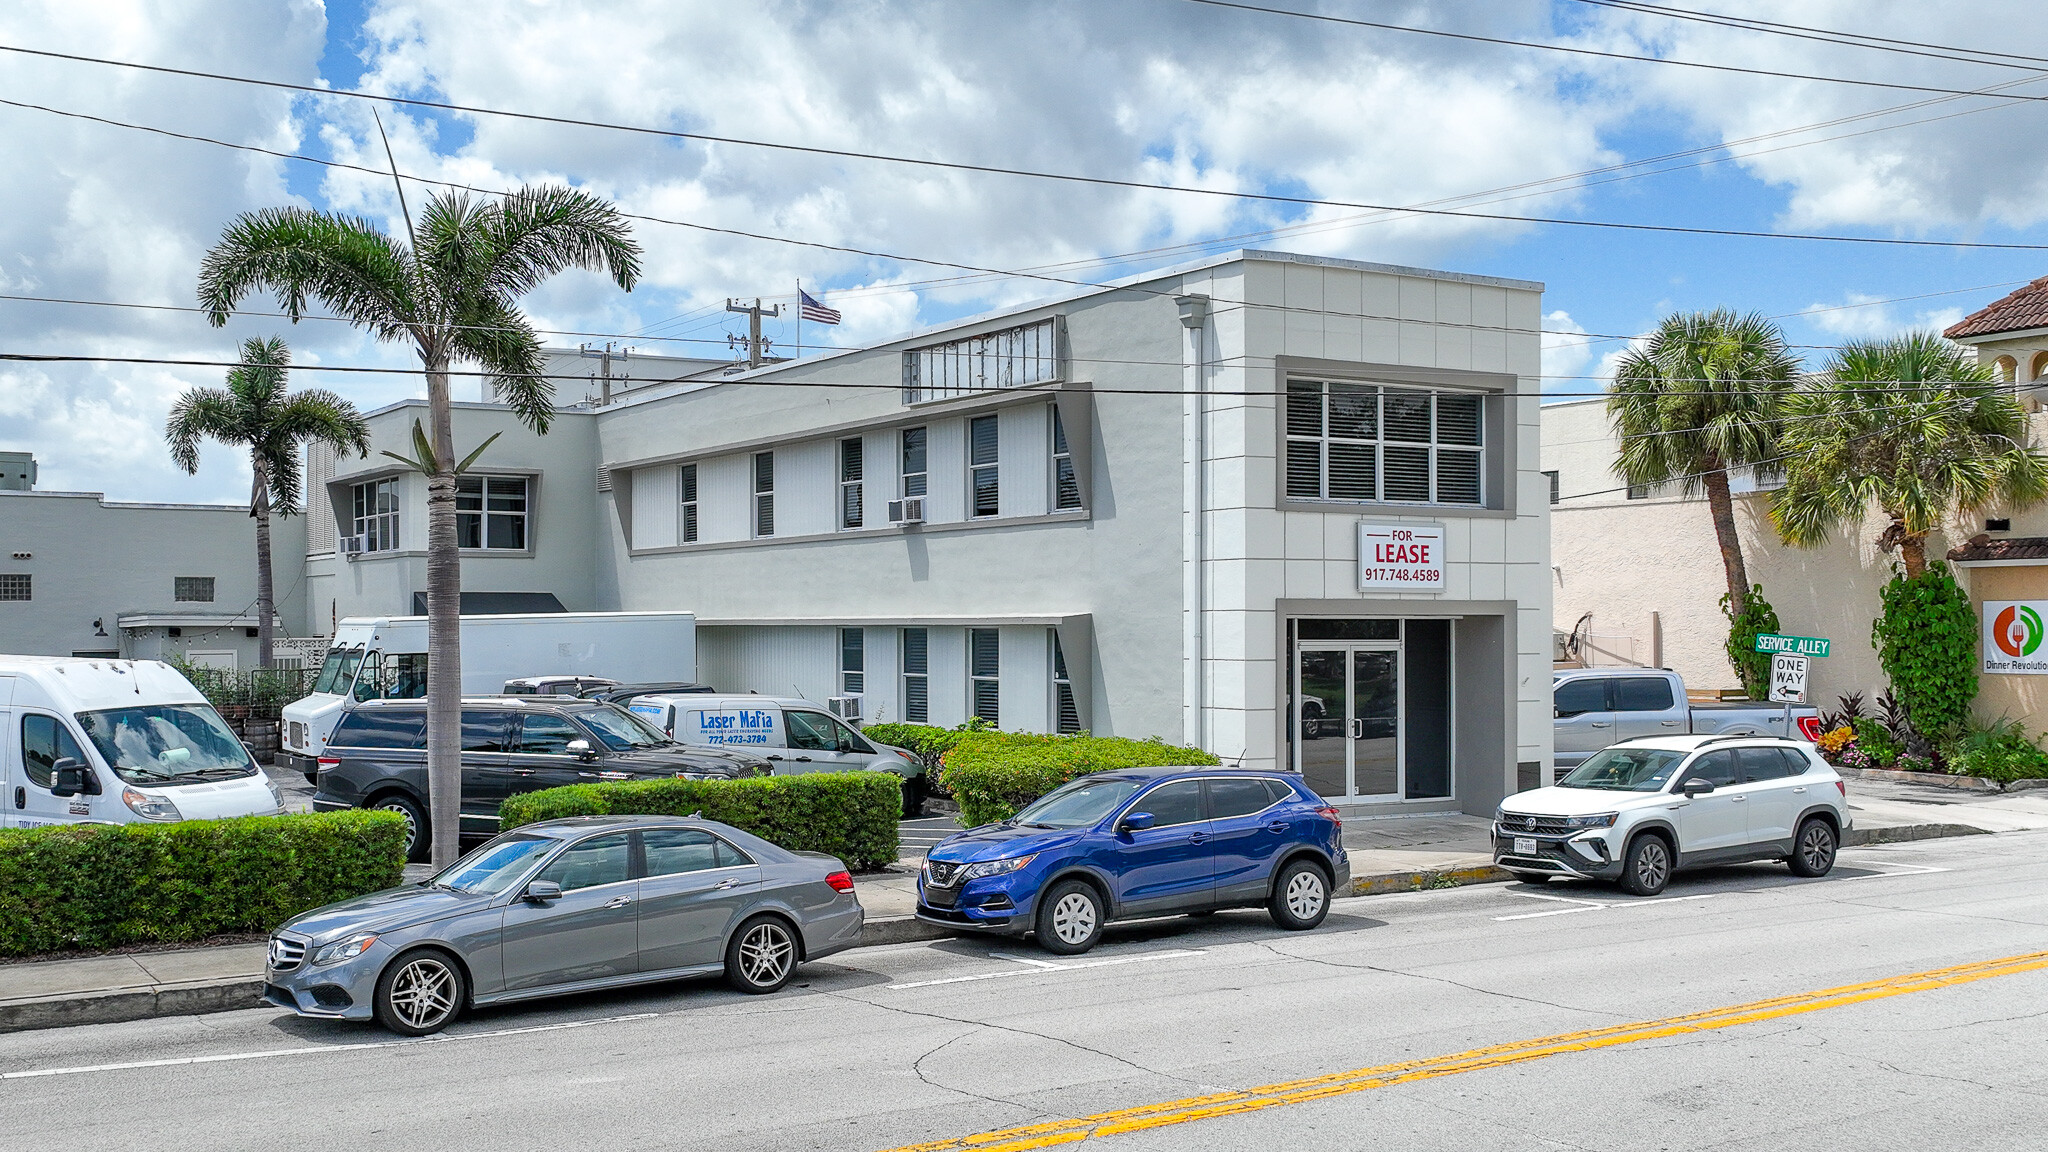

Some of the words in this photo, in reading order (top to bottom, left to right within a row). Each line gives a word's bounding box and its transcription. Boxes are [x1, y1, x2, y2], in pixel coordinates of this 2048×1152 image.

[1392, 530, 1413, 541] FOR
[1376, 543, 1430, 564] LEASE
[1365, 568, 1440, 582] 917.748.4589
[1757, 636, 1794, 652] SERVICE
[1797, 639, 1829, 654] ALLEY
[1777, 659, 1804, 671] ONE
[1986, 660, 2010, 670] Dinner
[2011, 660, 2048, 670] Revolutio
[1776, 672, 1804, 684] WAY
[700, 710, 736, 729] Laser
[739, 710, 773, 728] Mafia
[708, 734, 767, 744] 772-473-3784
